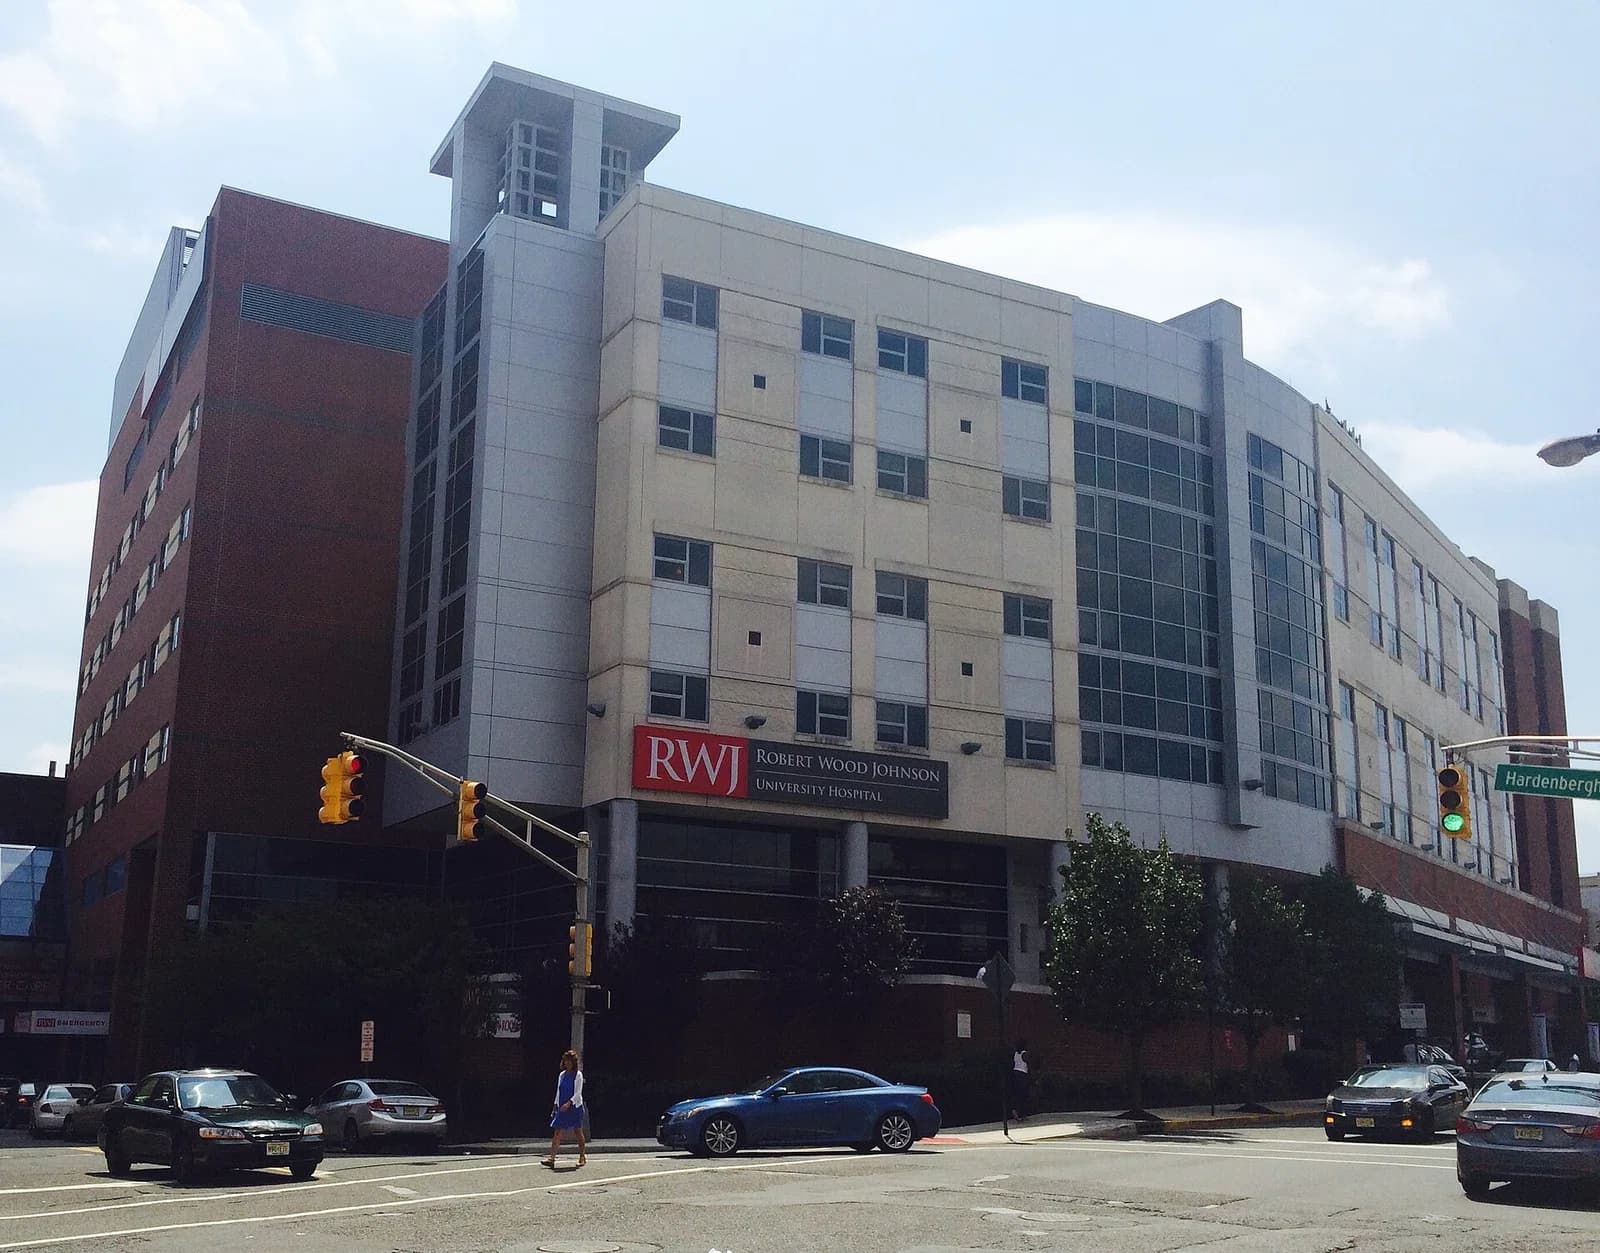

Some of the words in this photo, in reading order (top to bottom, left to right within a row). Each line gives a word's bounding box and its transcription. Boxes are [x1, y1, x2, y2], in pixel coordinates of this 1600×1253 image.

[646, 735, 744, 795] RWJ
[756, 748, 814, 769] ROBERT
[818, 755, 869, 775] WOOD
[871, 761, 941, 783] JOHNSON
[756, 777, 826, 796] UNIVERSITY
[828, 785, 883, 802] HOSPITAL
[57, 1018, 105, 1027] EMERGENCY
